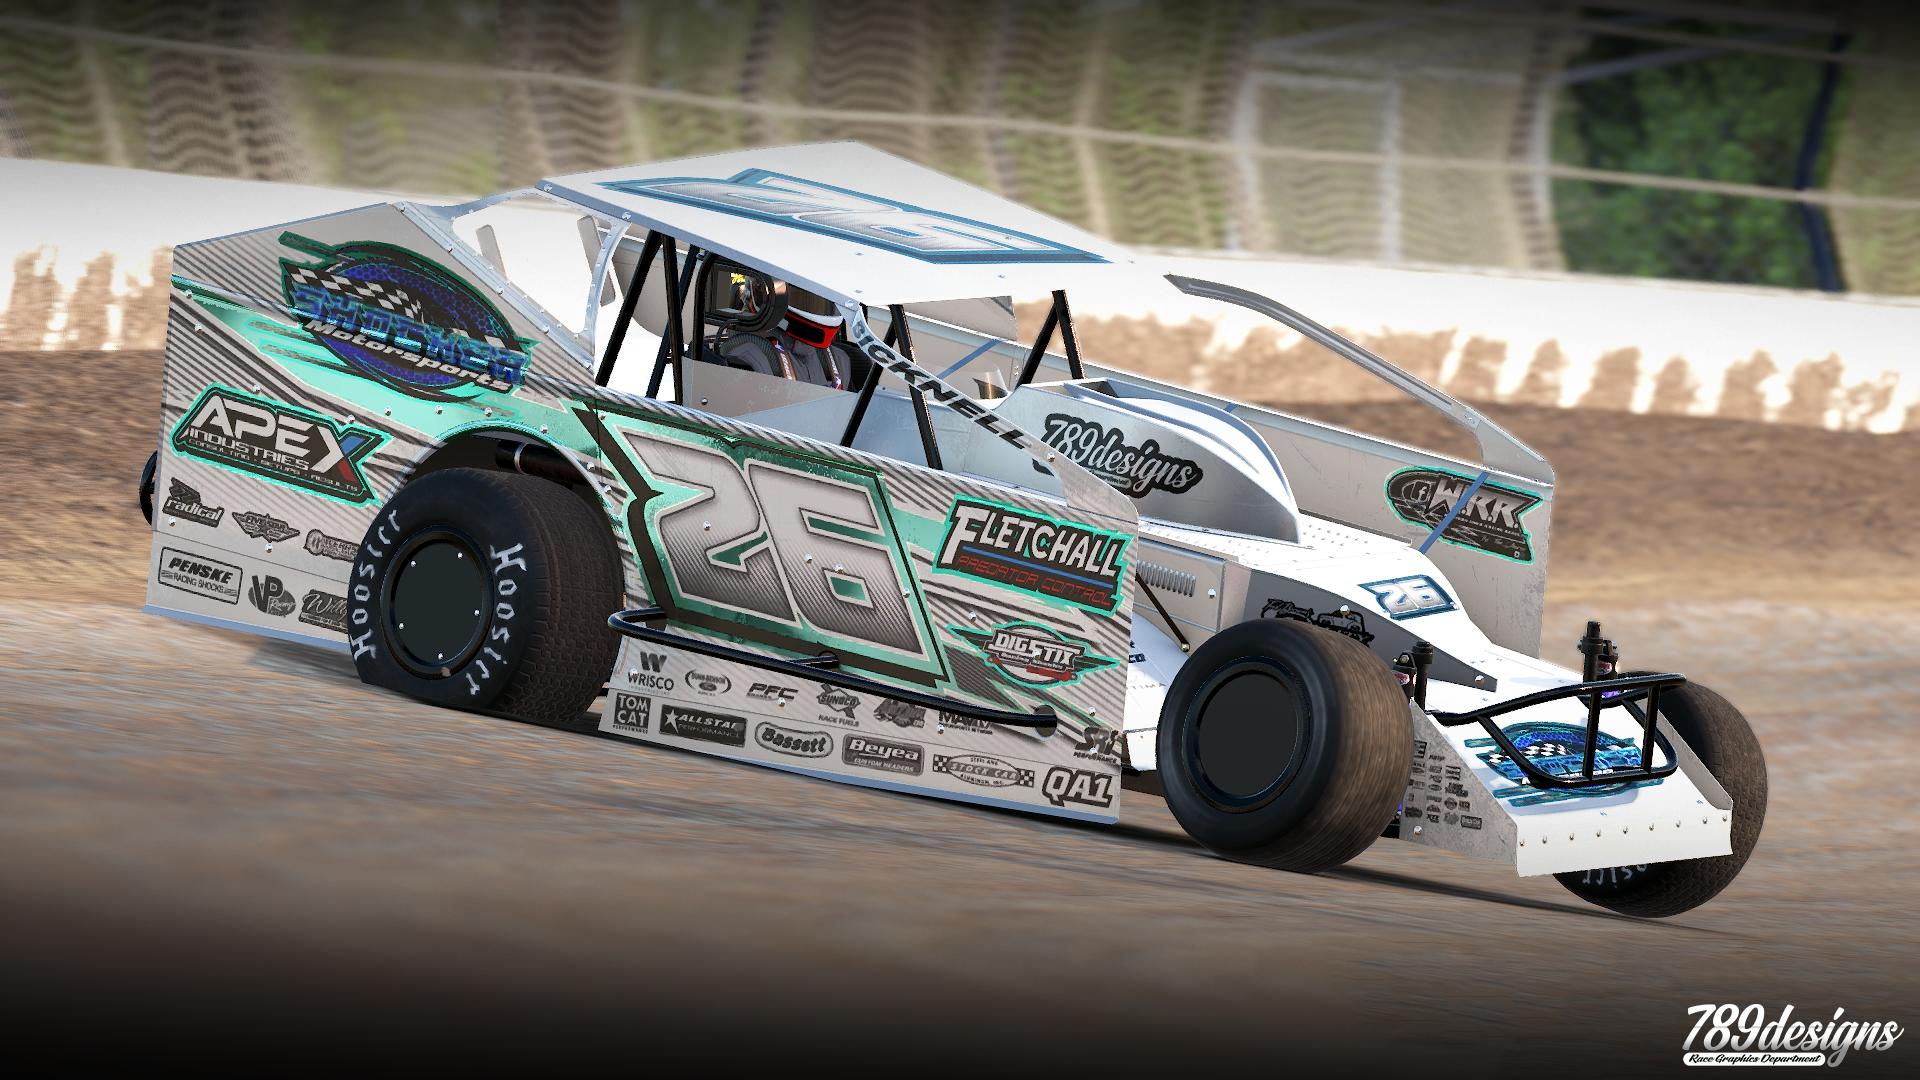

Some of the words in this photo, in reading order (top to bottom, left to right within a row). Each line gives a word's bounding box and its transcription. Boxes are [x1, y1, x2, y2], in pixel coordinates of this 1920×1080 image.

[304, 319, 514, 392] Motorsports
[851, 320, 1028, 450] BICKNELL
[186, 428, 311, 471] INDUSTRIES
[188, 394, 366, 484] APEX
[1045, 418, 1199, 493] 789designs
[165, 499, 224, 521] radical
[619, 429, 929, 660] 26
[940, 505, 1119, 577] FLETCHALL
[167, 556, 234, 585] PENSKE
[173, 572, 198, 587] RACING
[199, 580, 225, 595] SHOCKS
[957, 555, 1040, 587] PREDATOR
[1041, 577, 1113, 606] CONTROL
[251, 574, 284, 614] VP
[1368, 576, 1450, 614] 26
[989, 633, 1082, 667] DIGSTIX
[627, 671, 675, 692] WRISCO
[749, 682, 799, 700] PFC
[618, 694, 649, 712] TOM
[821, 693, 858, 707] SUNOCO
[617, 709, 648, 727] CAT
[818, 714, 838, 724] RACE
[761, 727, 827, 753] Bassett
[849, 738, 919, 761] Beyea
[950, 762, 992, 776] STOCK
[993, 767, 1018, 780] CAR
[1046, 768, 1113, 804] QA1
